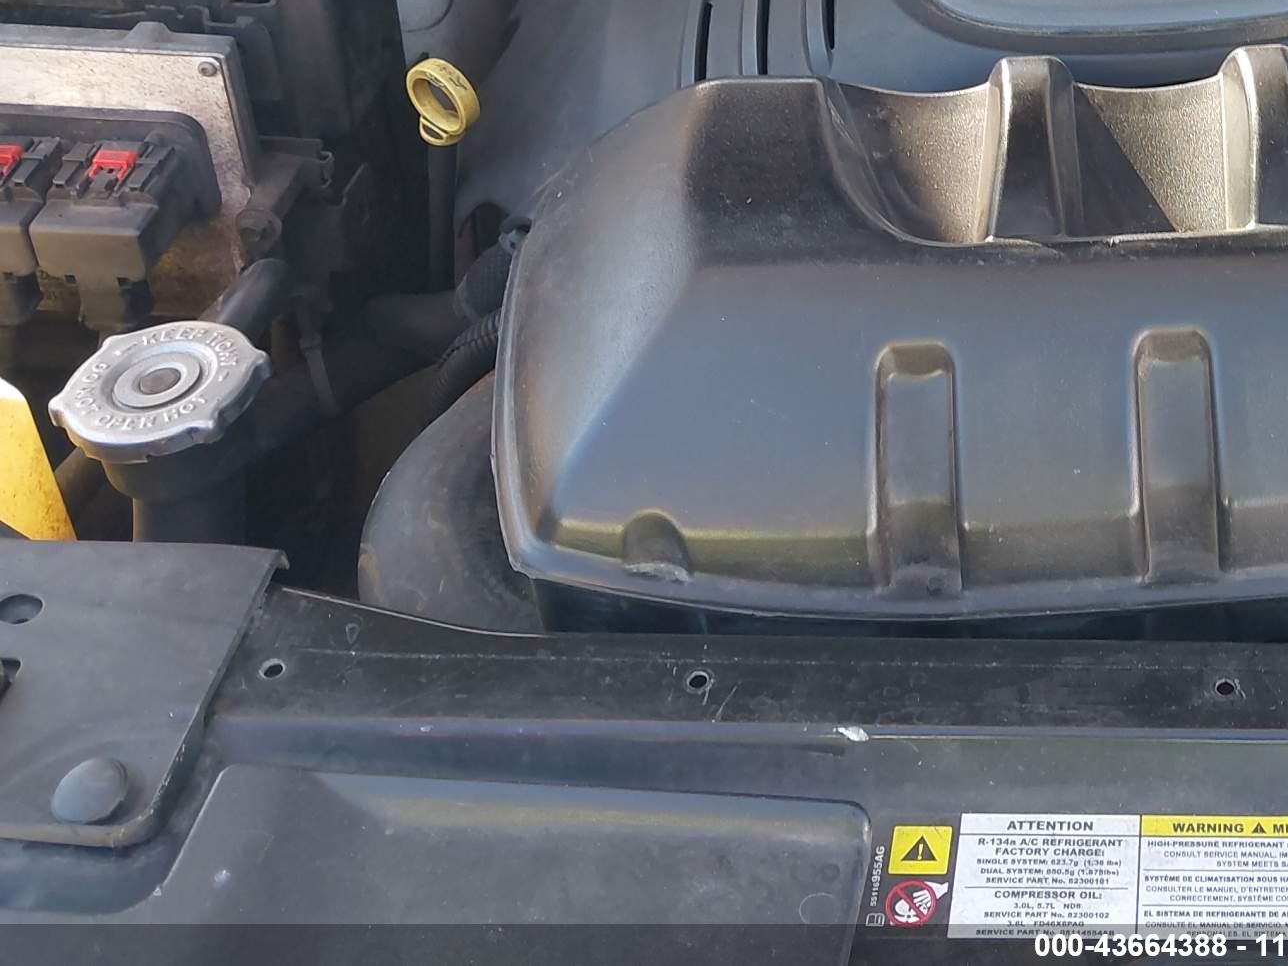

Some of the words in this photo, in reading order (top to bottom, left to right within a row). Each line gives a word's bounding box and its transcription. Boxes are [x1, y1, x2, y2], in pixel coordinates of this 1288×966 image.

[141, 326, 205, 347] KEEP
[97, 413, 157, 431] OPEN
[163, 394, 208, 424] HOT
[1007, 820, 1094, 832] ATTENTION
[1173, 823, 1244, 834] WARNING
[1020, 838, 1039, 847] A/C
[1042, 838, 1124, 847] REFRIGERANT
[995, 848, 1050, 856] FACTORY
[1053, 848, 1104, 857] CHARGE:
[1052, 877, 1066, 885] No.
[1257, 875, 1277, 883] SOUS
[994, 891, 1075, 899] COMPRESSOR
[1080, 891, 1103, 899] OIL:
[1269, 910, 1279, 918] DE
